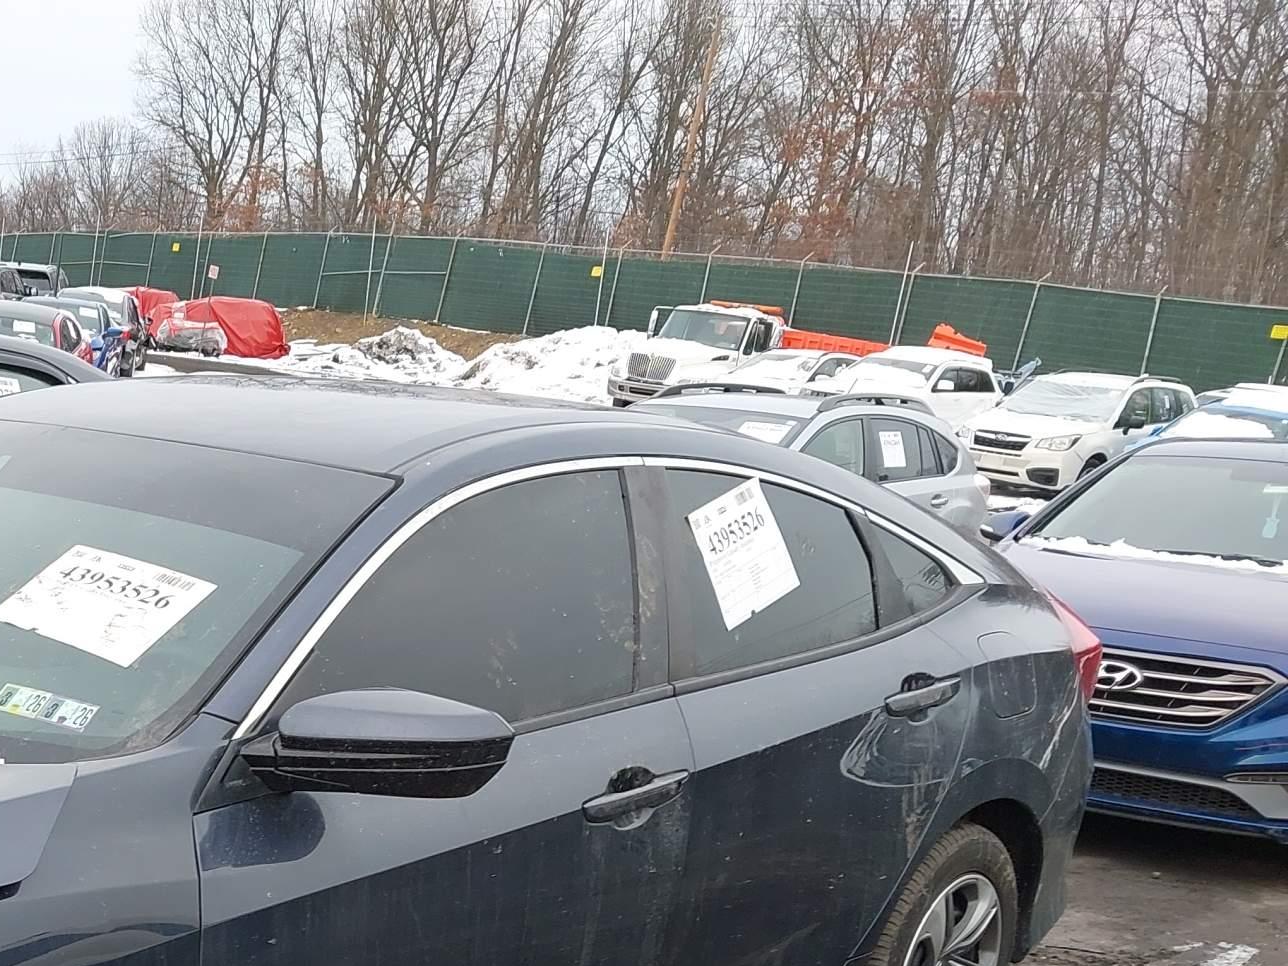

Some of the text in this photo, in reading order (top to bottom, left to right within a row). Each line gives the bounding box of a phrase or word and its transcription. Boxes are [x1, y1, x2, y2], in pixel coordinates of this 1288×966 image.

[708, 506, 765, 555] 43953526
[59, 565, 176, 609] 43953526
[0, 691, 13, 706] 3
[44, 703, 59, 719] 3
